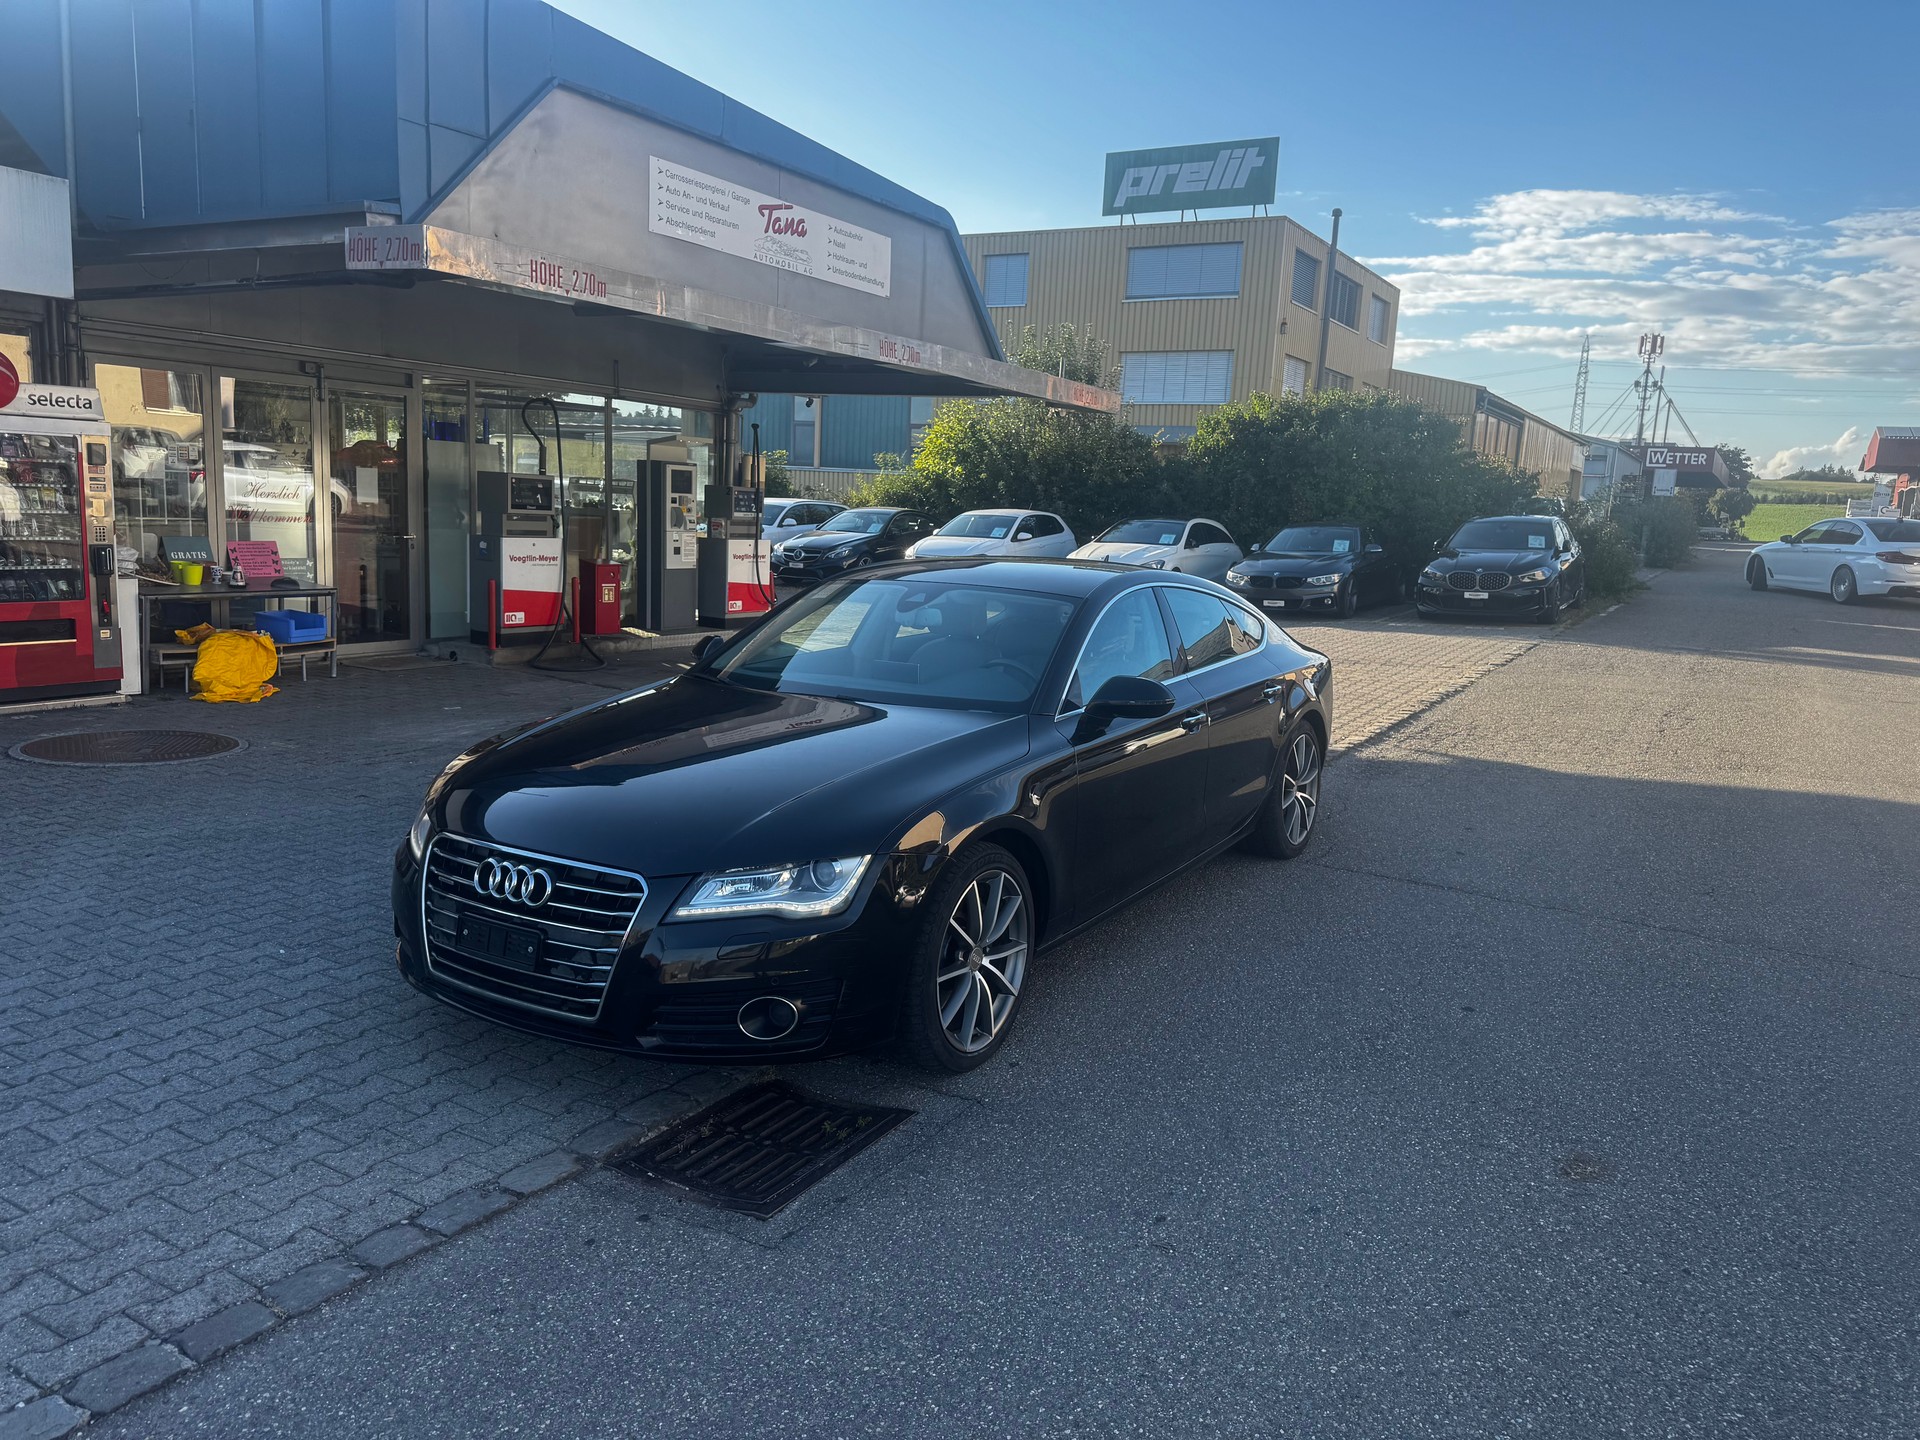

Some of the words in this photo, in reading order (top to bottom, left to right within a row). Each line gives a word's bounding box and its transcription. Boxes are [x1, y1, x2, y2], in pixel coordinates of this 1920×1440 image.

[665, 169, 726, 196] Carrosseriespenglerei
[731, 191, 751, 205] Garage
[1113, 147, 1265, 208] prelit
[665, 185, 681, 197] Auto
[682, 190, 694, 200] An-
[696, 195, 707, 205] und
[708, 198, 730, 212] Verkauf
[665, 200, 690, 215] Service
[692, 209, 703, 219] und
[705, 212, 740, 230] Reparaturen
[758, 203, 807, 238] Tana
[665, 217, 716, 238] Abschleppdienst
[349, 232, 377, 262] HÖHE
[530, 257, 563, 289] HÖHE
[753, 252, 798, 271] AUTOMOBIL
[803, 267, 813, 275] AG
[880, 337, 897, 359] HÖHE
[27, 392, 93, 410] selecta
[1651, 449, 1707, 465] WETTER
[243, 481, 301, 499] Herzlich
[536, 494, 541, 503] 1
[751, 503, 756, 511] 2
[171, 551, 207, 559] GRATIS
[509, 554, 558, 563] Voegtlin-Meyer
